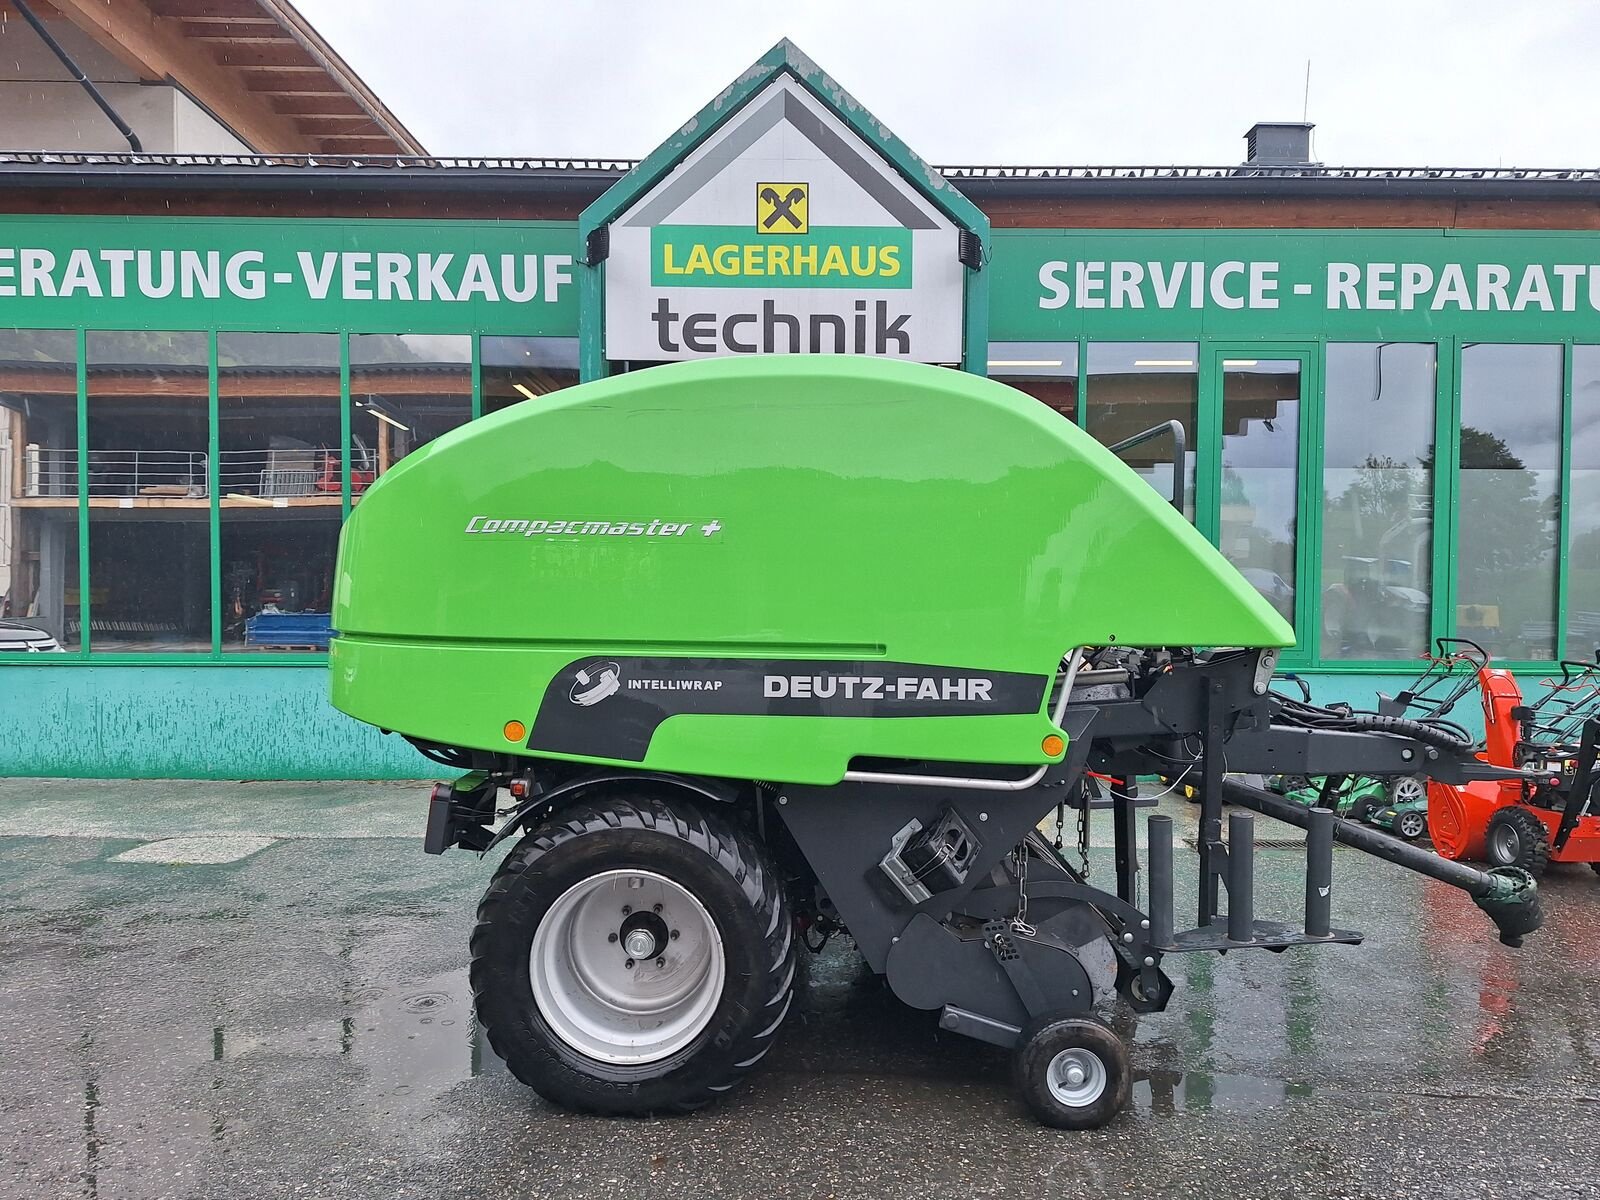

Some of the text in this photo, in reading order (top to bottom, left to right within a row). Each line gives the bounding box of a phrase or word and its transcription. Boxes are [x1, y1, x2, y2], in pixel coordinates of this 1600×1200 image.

[663, 243, 901, 277] LAGERHAUS
[1038, 261, 1279, 309] SERVICE
[651, 298, 912, 355] technik
[464, 516, 693, 537] Compacmaster
[627, 679, 723, 691] INTELLIWRAP
[763, 674, 993, 701] DEUTZ-FAHR
